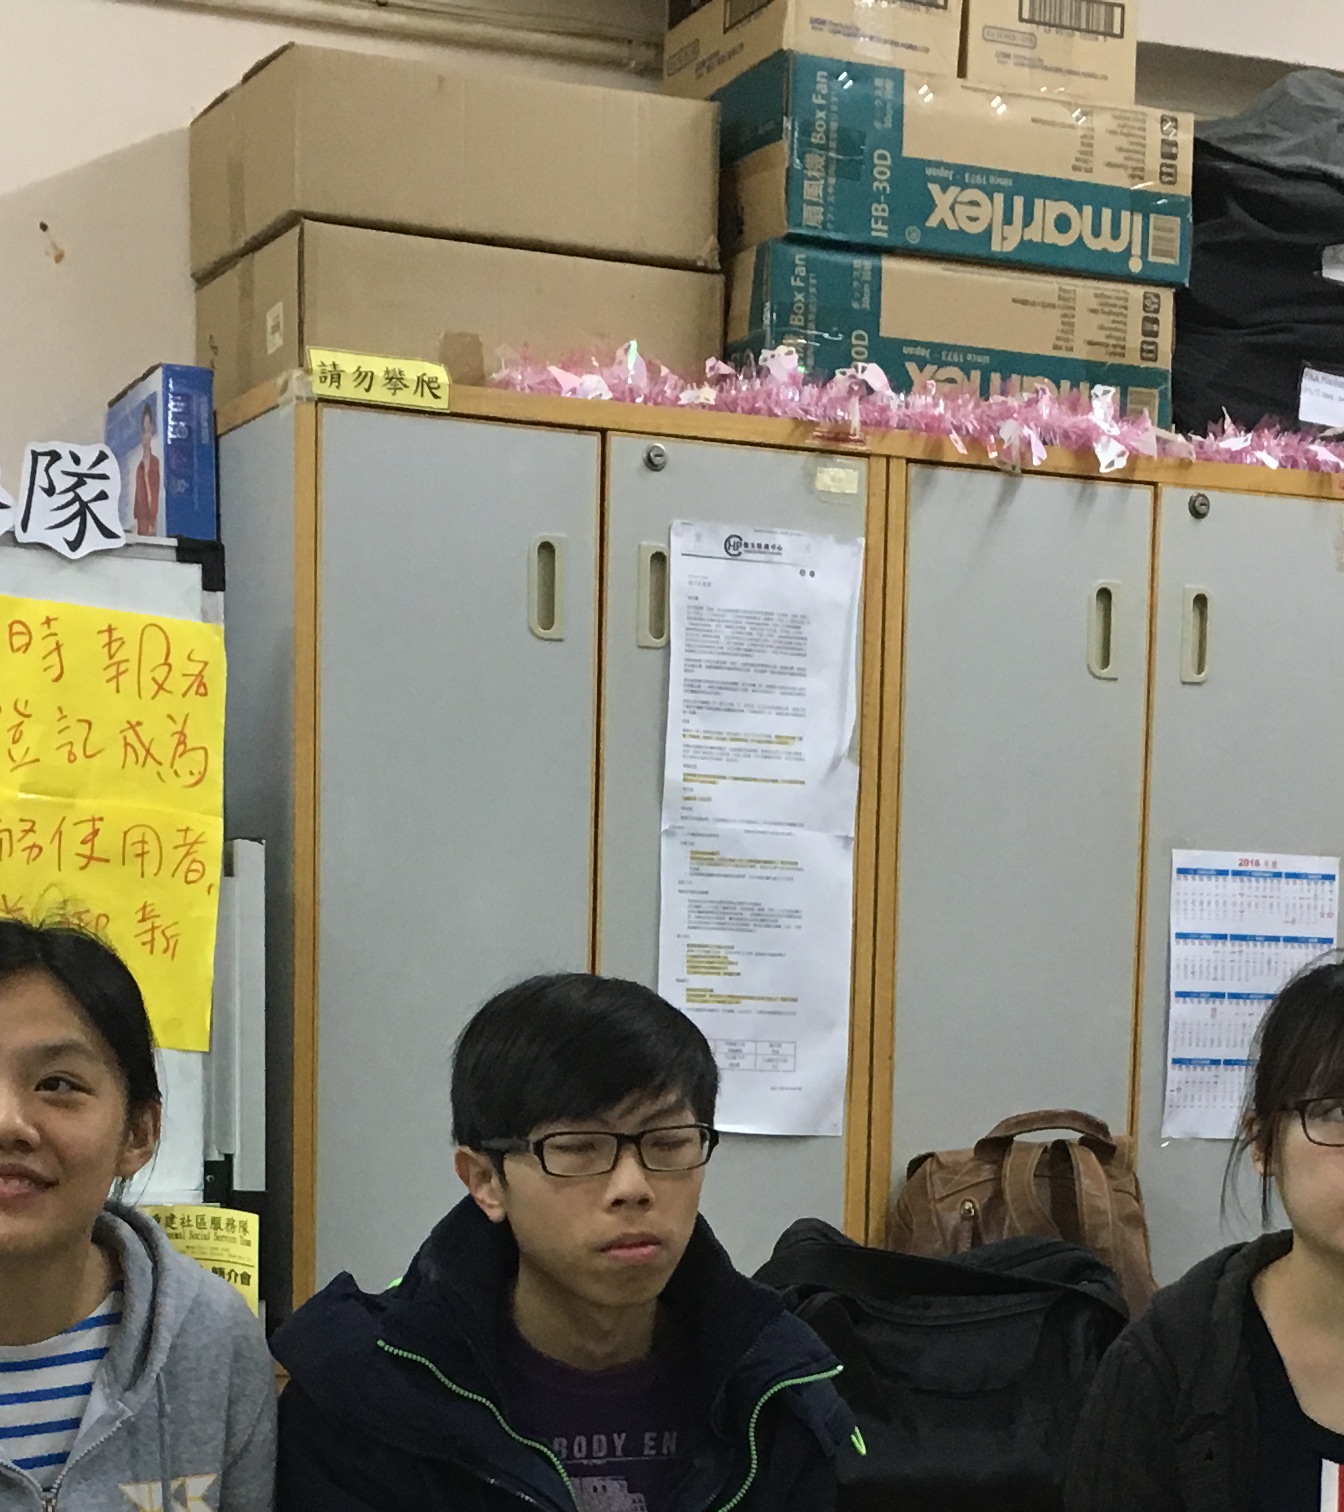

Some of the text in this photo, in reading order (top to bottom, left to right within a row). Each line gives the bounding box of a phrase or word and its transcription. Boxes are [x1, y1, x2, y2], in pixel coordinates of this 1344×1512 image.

[811, 70, 828, 145] Box Fan
[925, 166, 1013, 187] since 1973 Japan
[871, 149, 892, 238] IFB-30D
[924, 182, 1143, 273] imarflex
[791, 253, 806, 285] Fan
[789, 287, 805, 326] Box
[902, 345, 931, 360] Japan
[941, 351, 964, 363] 1973
[316, 360, 442, 400] 請勿攀爬
[1238, 857, 1261, 869] 2016
[189, 1230, 211, 1242] Social
